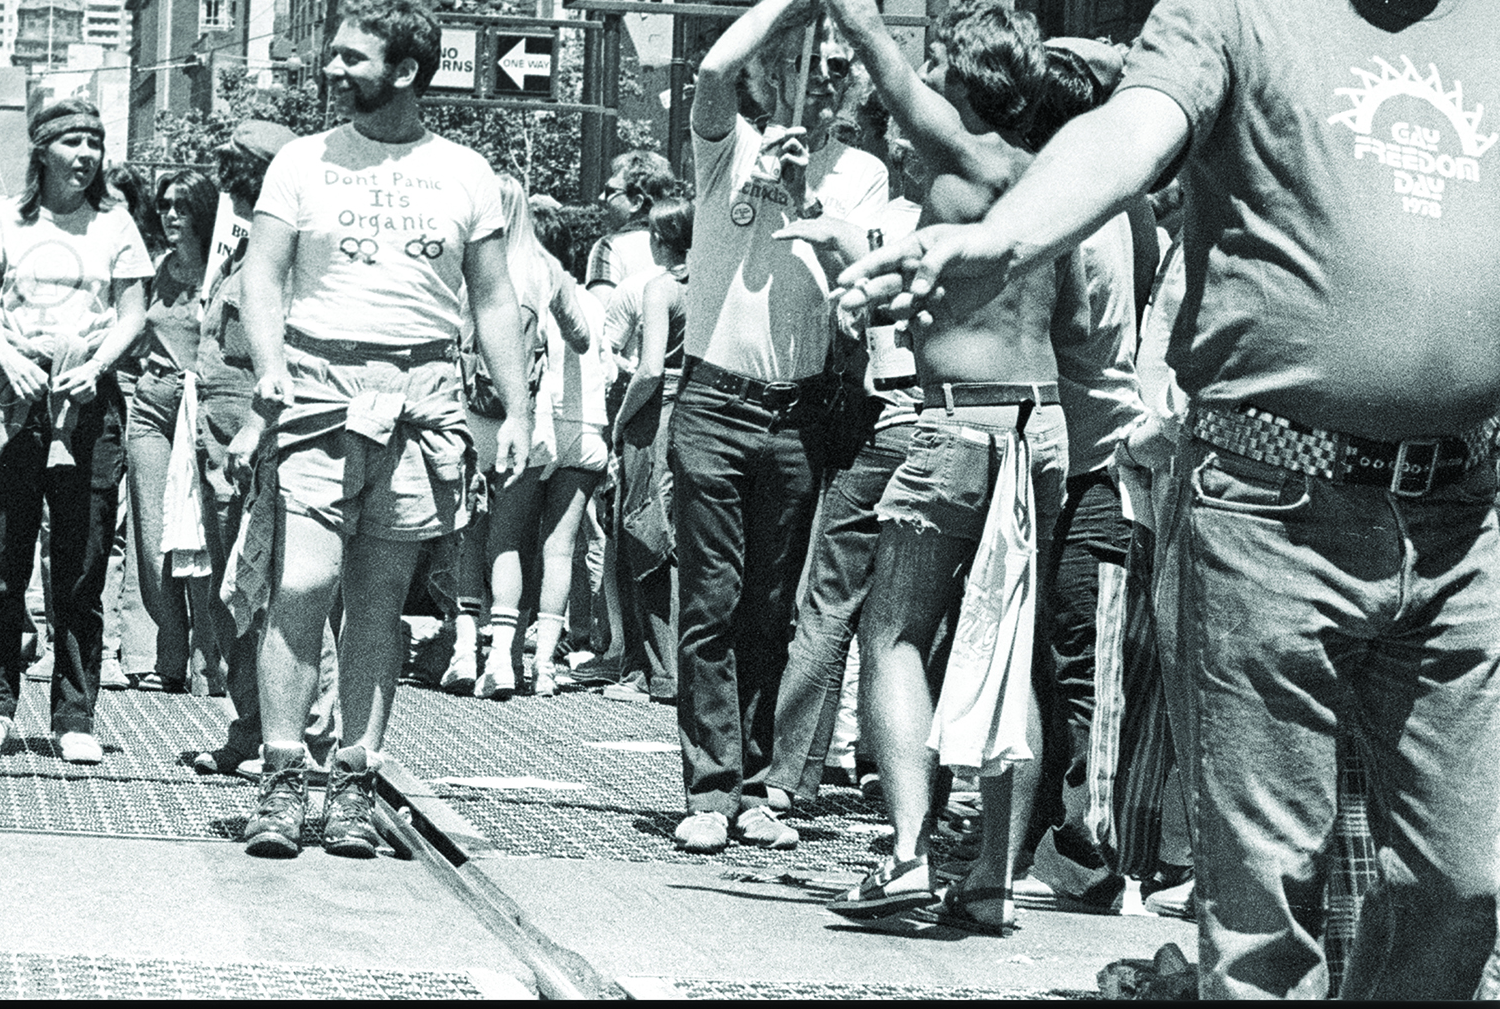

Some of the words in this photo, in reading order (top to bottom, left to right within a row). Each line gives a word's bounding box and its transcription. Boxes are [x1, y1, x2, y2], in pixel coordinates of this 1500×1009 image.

[503, 59, 525, 68] ONE
[527, 60, 550, 69] WAY
[393, 172, 442, 191] Panic
[1393, 169, 1445, 201] DAY
[338, 209, 438, 237] Organic
